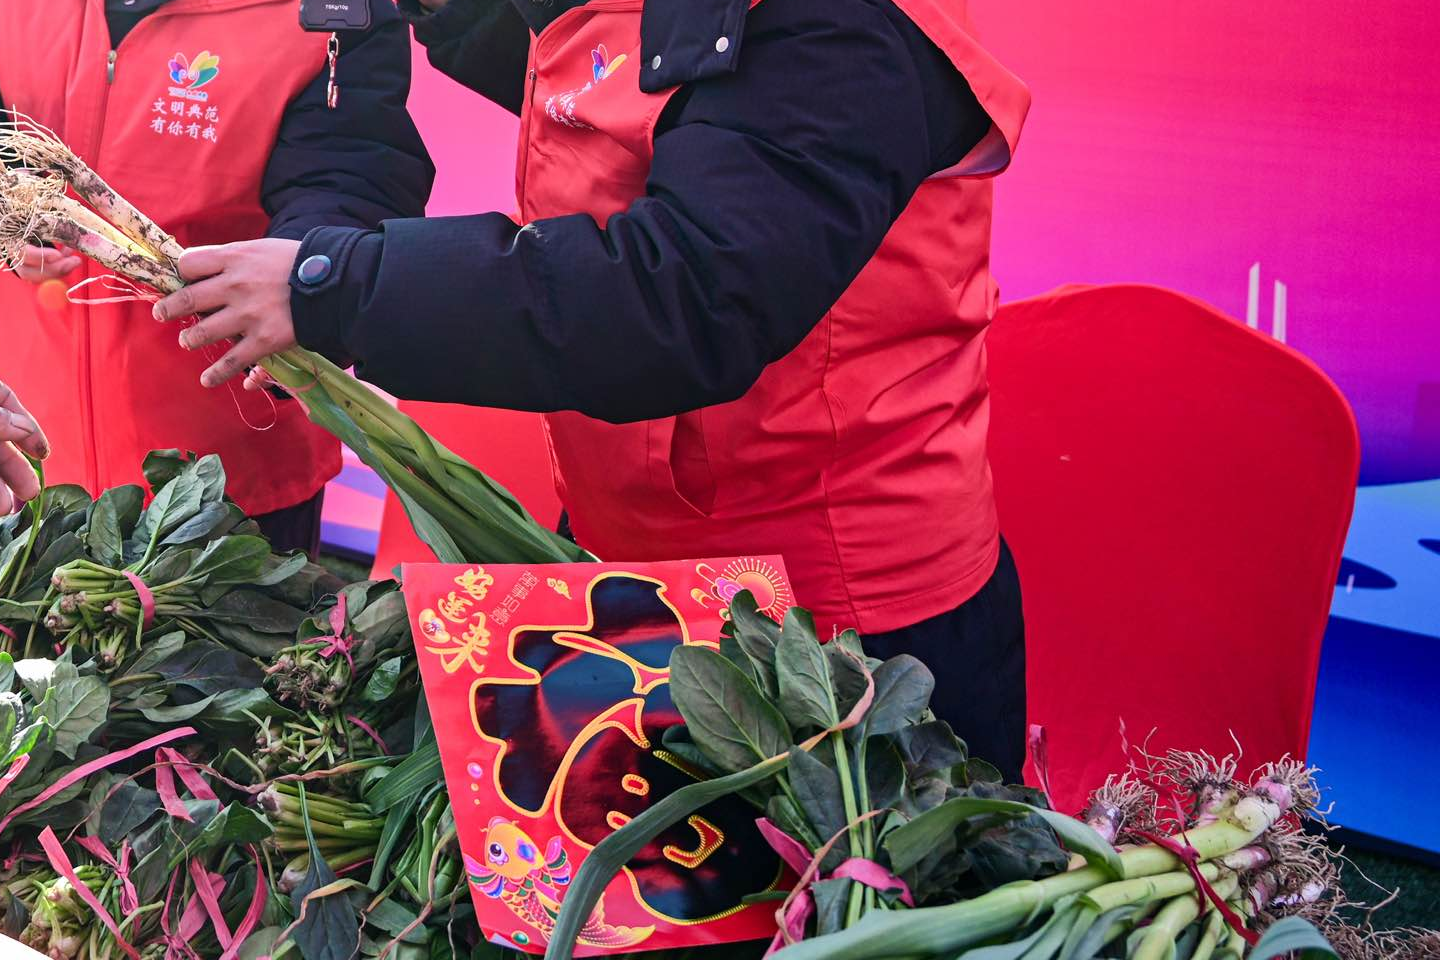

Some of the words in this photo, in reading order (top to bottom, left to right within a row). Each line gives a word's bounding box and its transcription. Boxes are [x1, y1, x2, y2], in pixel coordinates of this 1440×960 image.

[151, 97, 220, 123] 文明典范
[149, 116, 218, 144] 有你有我
